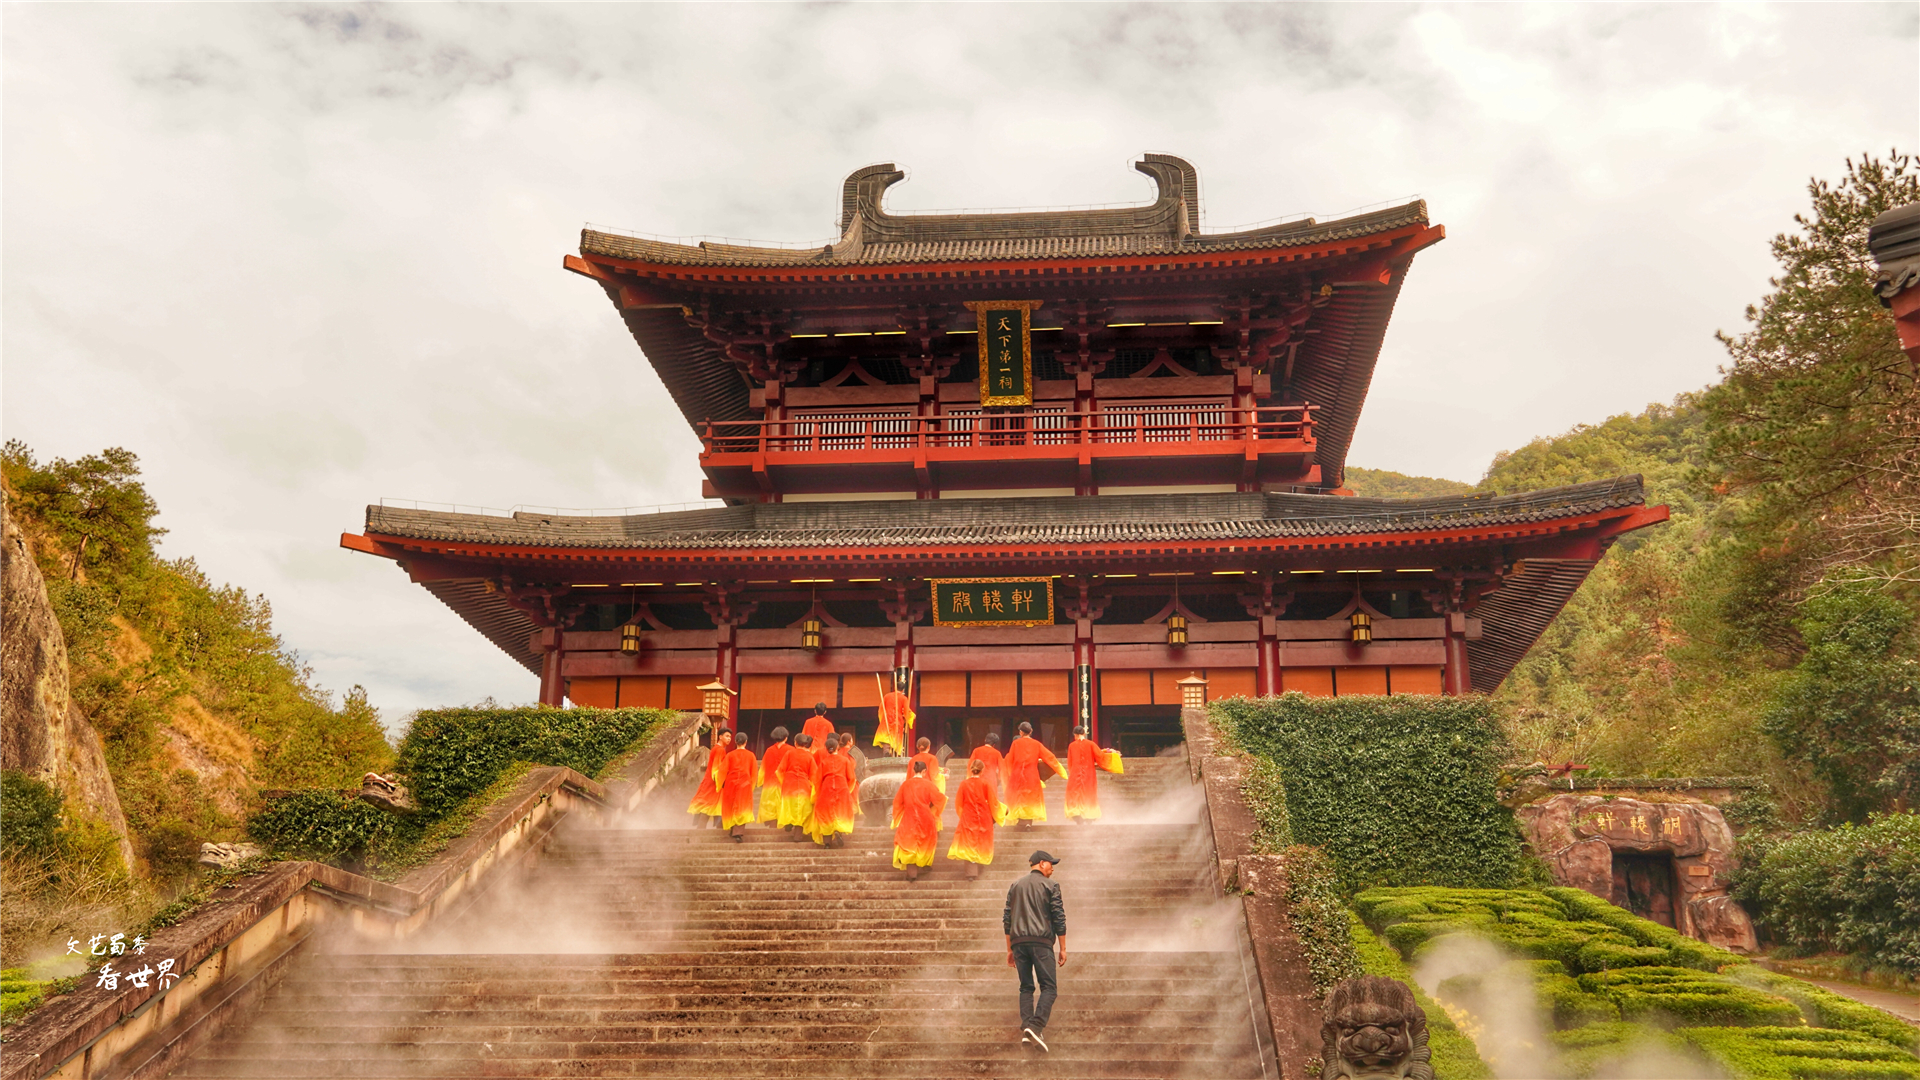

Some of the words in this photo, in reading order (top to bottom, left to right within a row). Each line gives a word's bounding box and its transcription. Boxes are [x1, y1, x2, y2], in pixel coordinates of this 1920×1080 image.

[997, 317, 1012, 389] 天下第一祠
